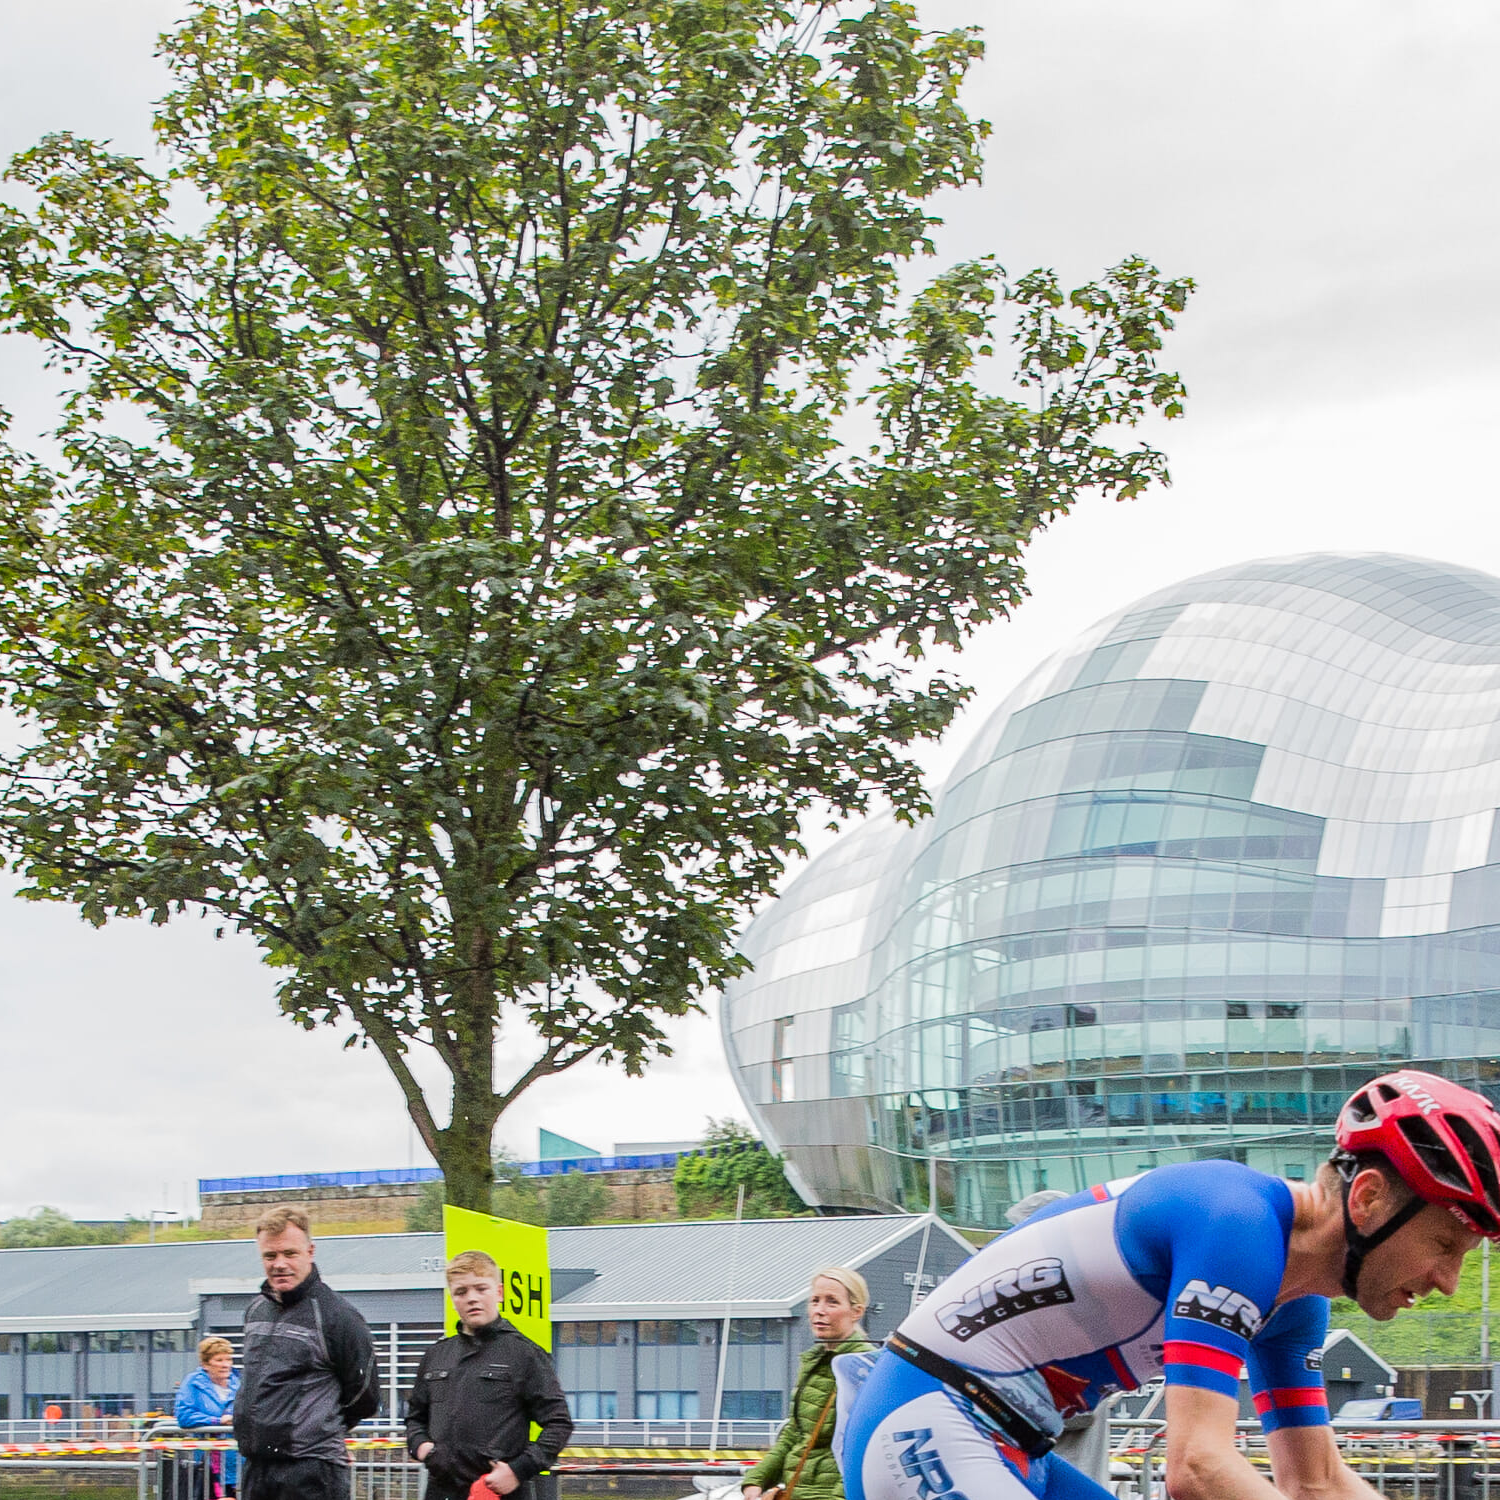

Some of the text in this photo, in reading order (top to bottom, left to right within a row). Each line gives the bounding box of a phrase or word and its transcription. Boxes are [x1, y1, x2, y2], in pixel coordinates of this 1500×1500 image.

[1392, 1076, 1441, 1116] KASK
[500, 1268, 543, 1319] ISH
[935, 1257, 1064, 1333] NRG
[956, 1290, 1068, 1337] CYCLES
[1177, 1305, 1252, 1338] CYCL
[882, 1434, 906, 1488] GLOBAL
